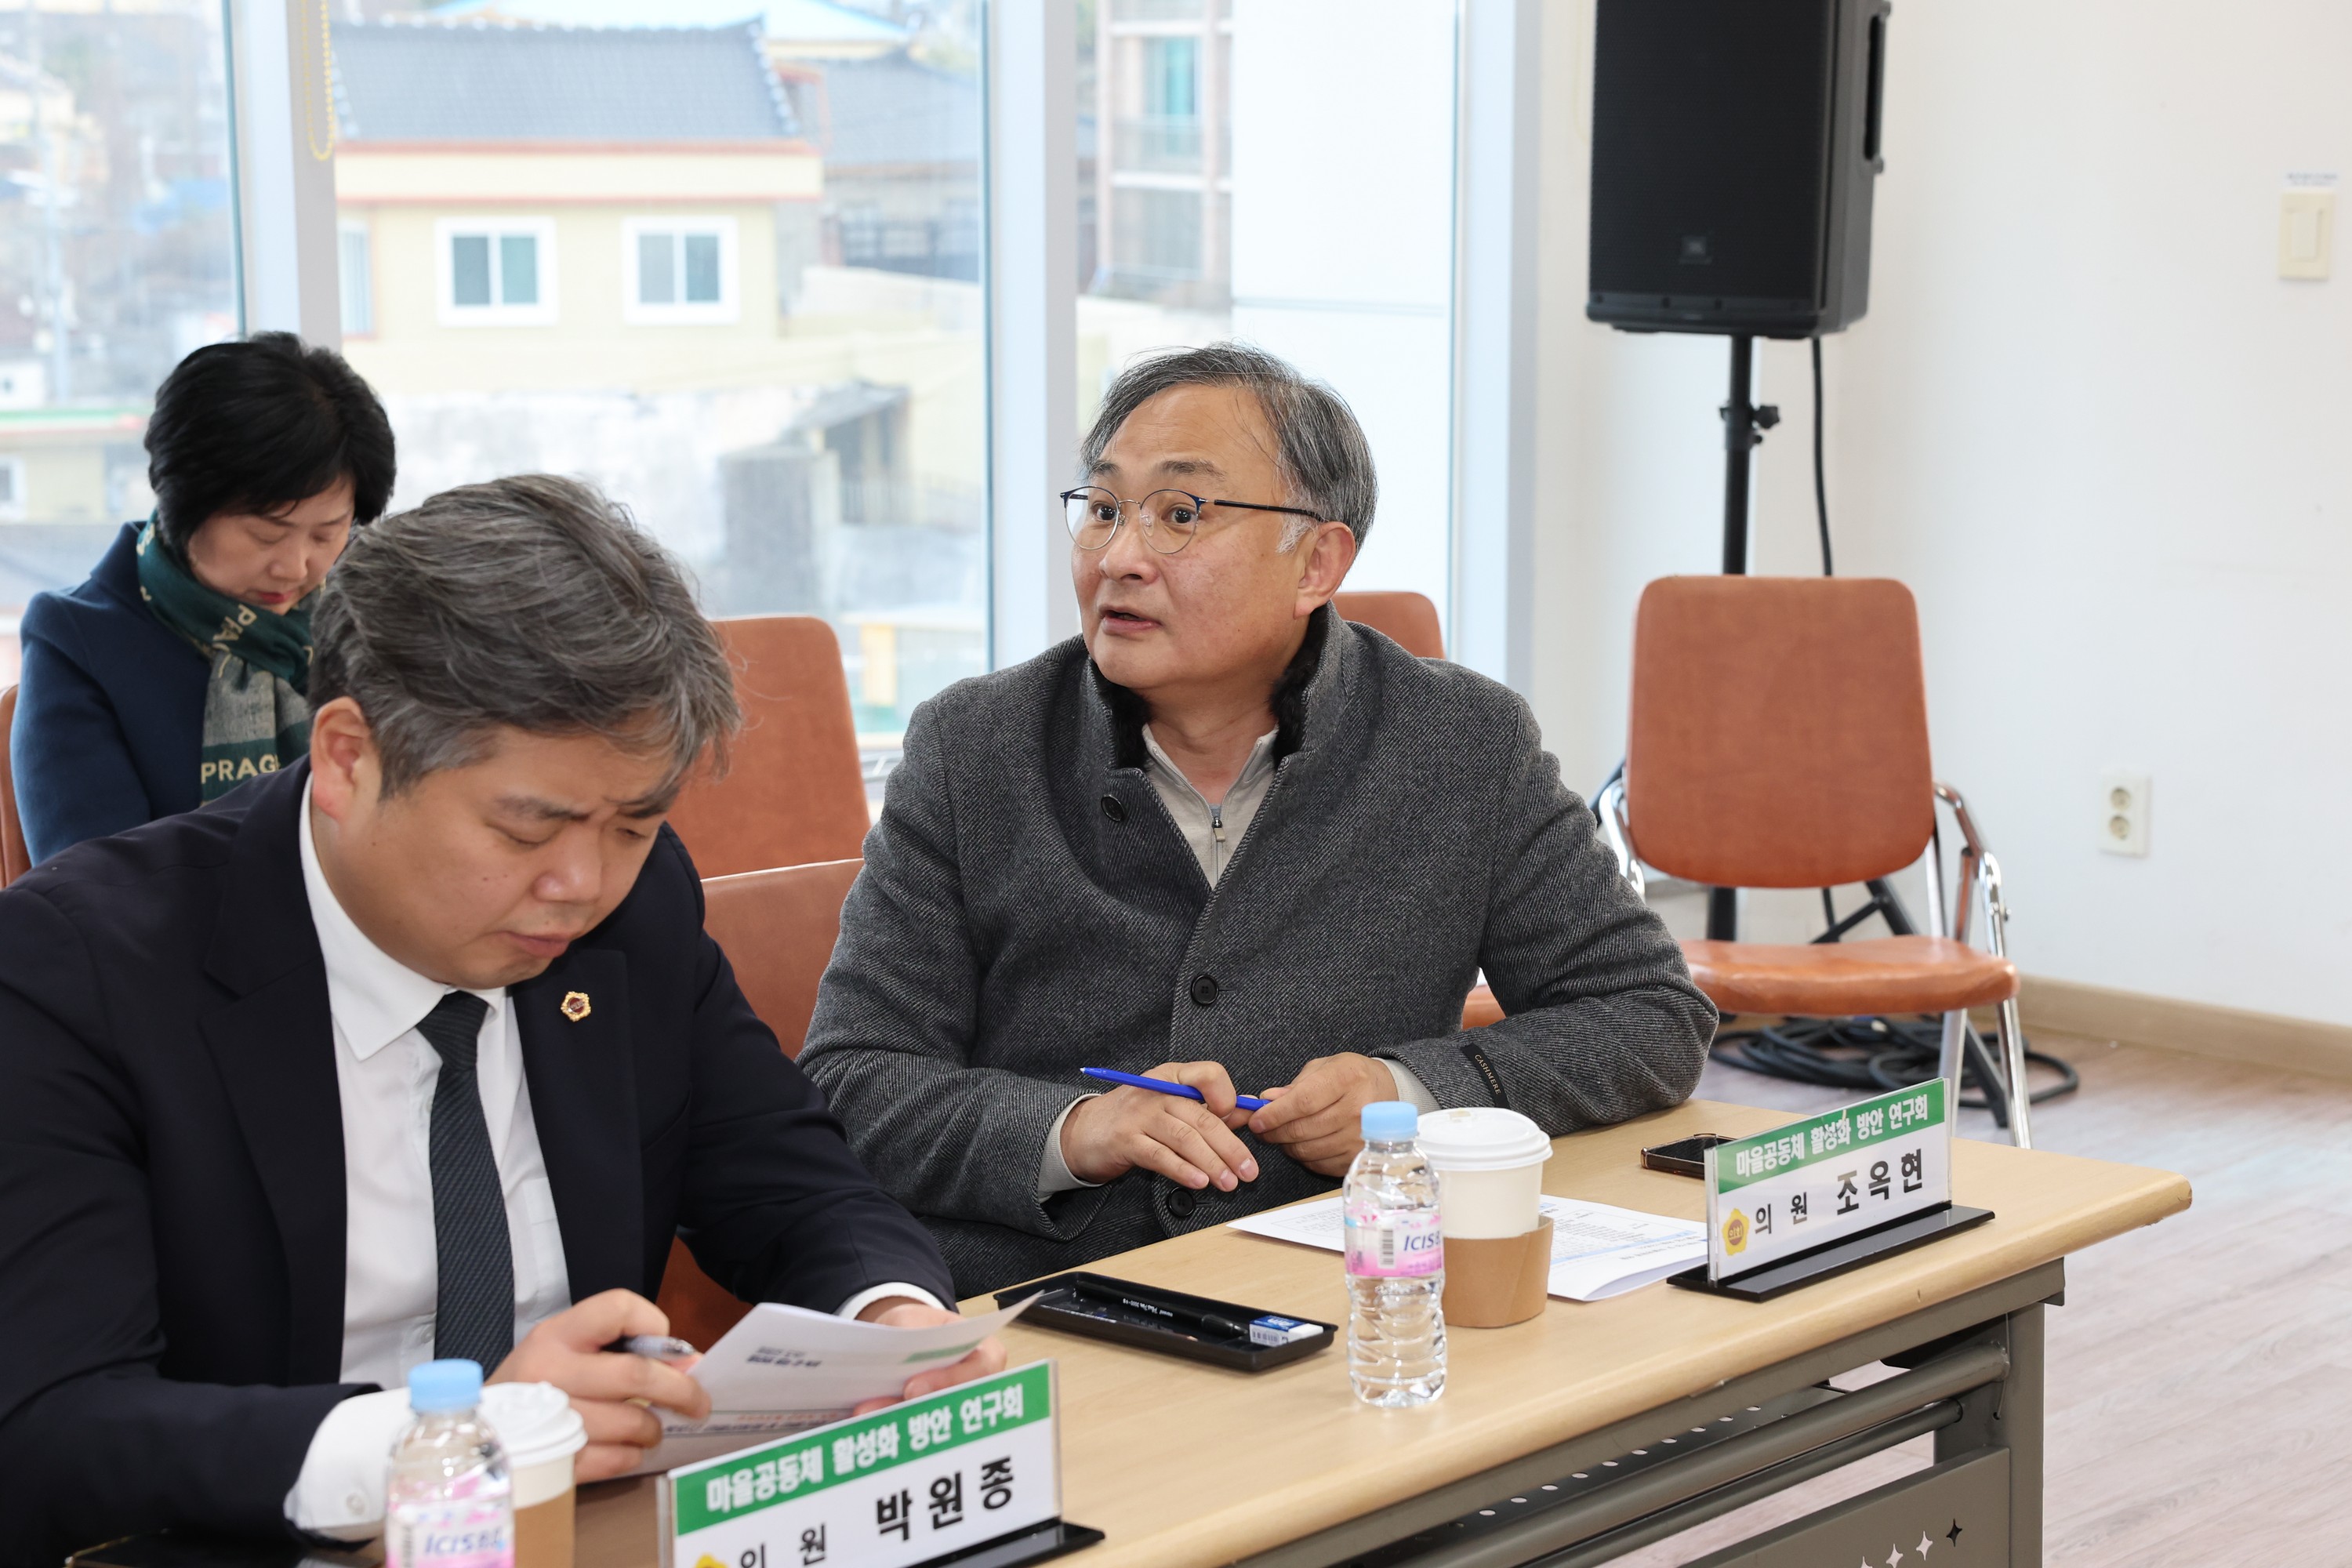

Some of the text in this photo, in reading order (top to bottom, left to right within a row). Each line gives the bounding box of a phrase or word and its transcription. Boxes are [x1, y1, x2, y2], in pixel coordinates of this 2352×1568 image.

[201, 753, 280, 784] PRAG
[1475, 1054, 1501, 1094] CASHMERE
[1735, 1094, 1928, 1177] 마을공동체 활성화 방안 연구회
[1837, 1148, 1922, 1215] 조옥현
[706, 1383, 1023, 1513] 마을공동체 활성화 방안 연구회
[876, 1457, 1014, 1541] 박원종
